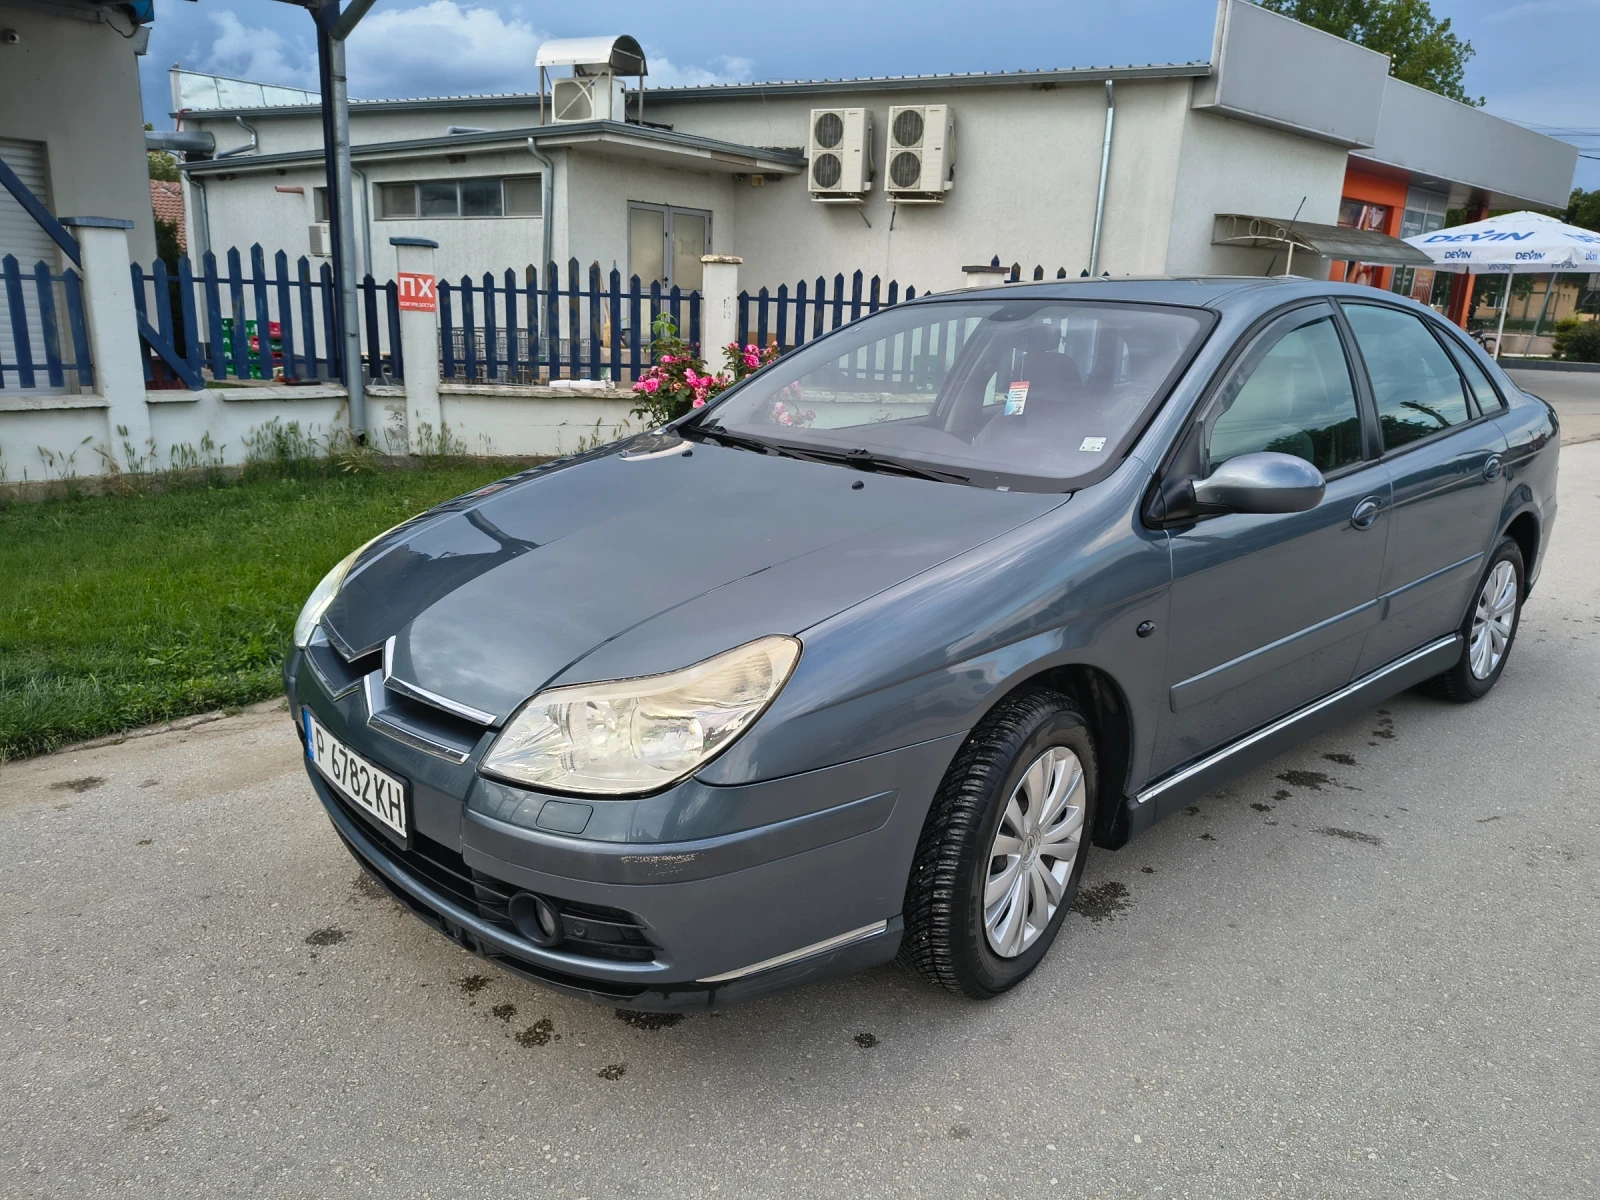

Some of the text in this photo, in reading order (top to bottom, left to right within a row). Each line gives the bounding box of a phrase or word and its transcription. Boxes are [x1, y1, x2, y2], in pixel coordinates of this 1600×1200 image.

[1423, 229, 1535, 243] DEVIN
[1444, 248, 1472, 259] DEVIN
[1515, 249, 1546, 260] DEVIN
[399, 276, 434, 298] ПХ
[315, 726, 403, 829] P 6782KH
